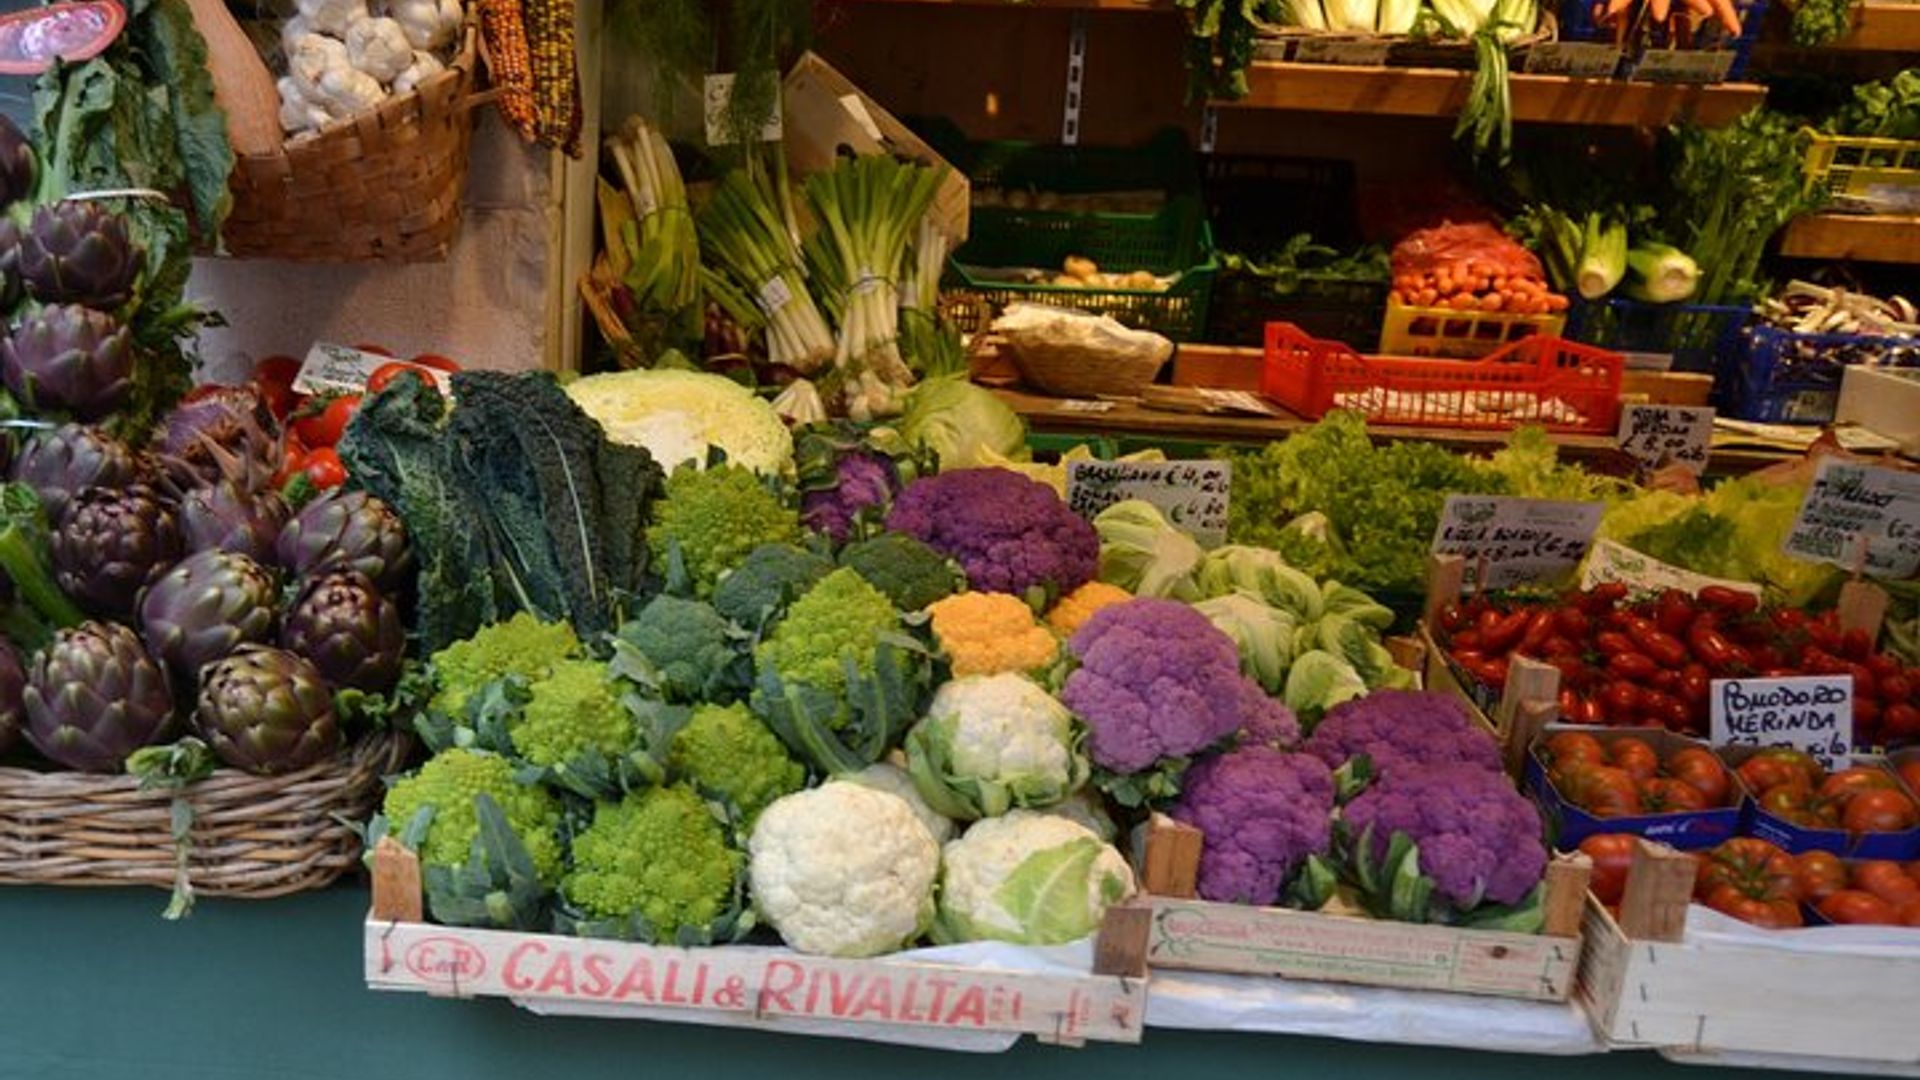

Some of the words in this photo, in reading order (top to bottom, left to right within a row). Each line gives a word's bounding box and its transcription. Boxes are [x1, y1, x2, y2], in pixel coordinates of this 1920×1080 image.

[1723, 681, 1847, 711] POMODORO
[501, 941, 710, 1005] CASALI
[758, 959, 986, 1027] RIVALTA
